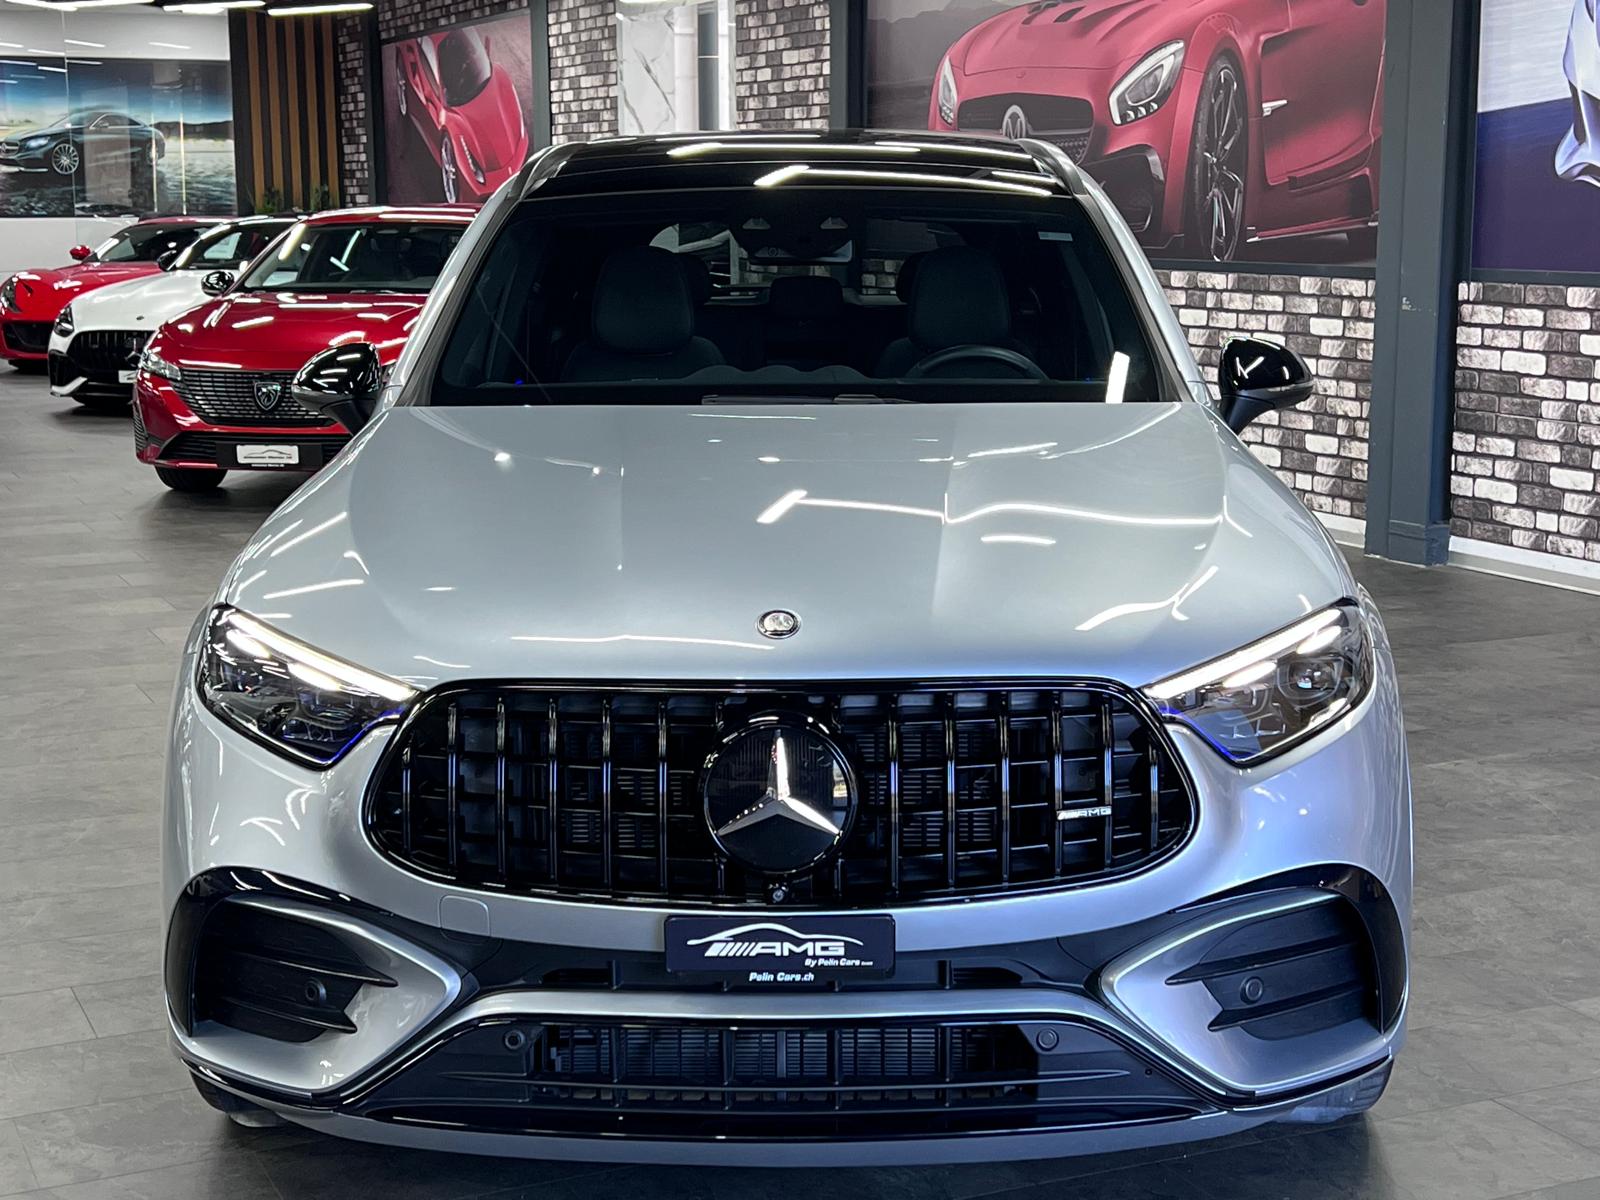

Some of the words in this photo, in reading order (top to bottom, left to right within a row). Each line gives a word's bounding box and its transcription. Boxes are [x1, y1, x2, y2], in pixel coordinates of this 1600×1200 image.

[1075, 806, 1112, 817] AMG
[748, 941, 845, 957] AMG
[804, 957, 817, 968] By
[839, 957, 861, 967] Cars
